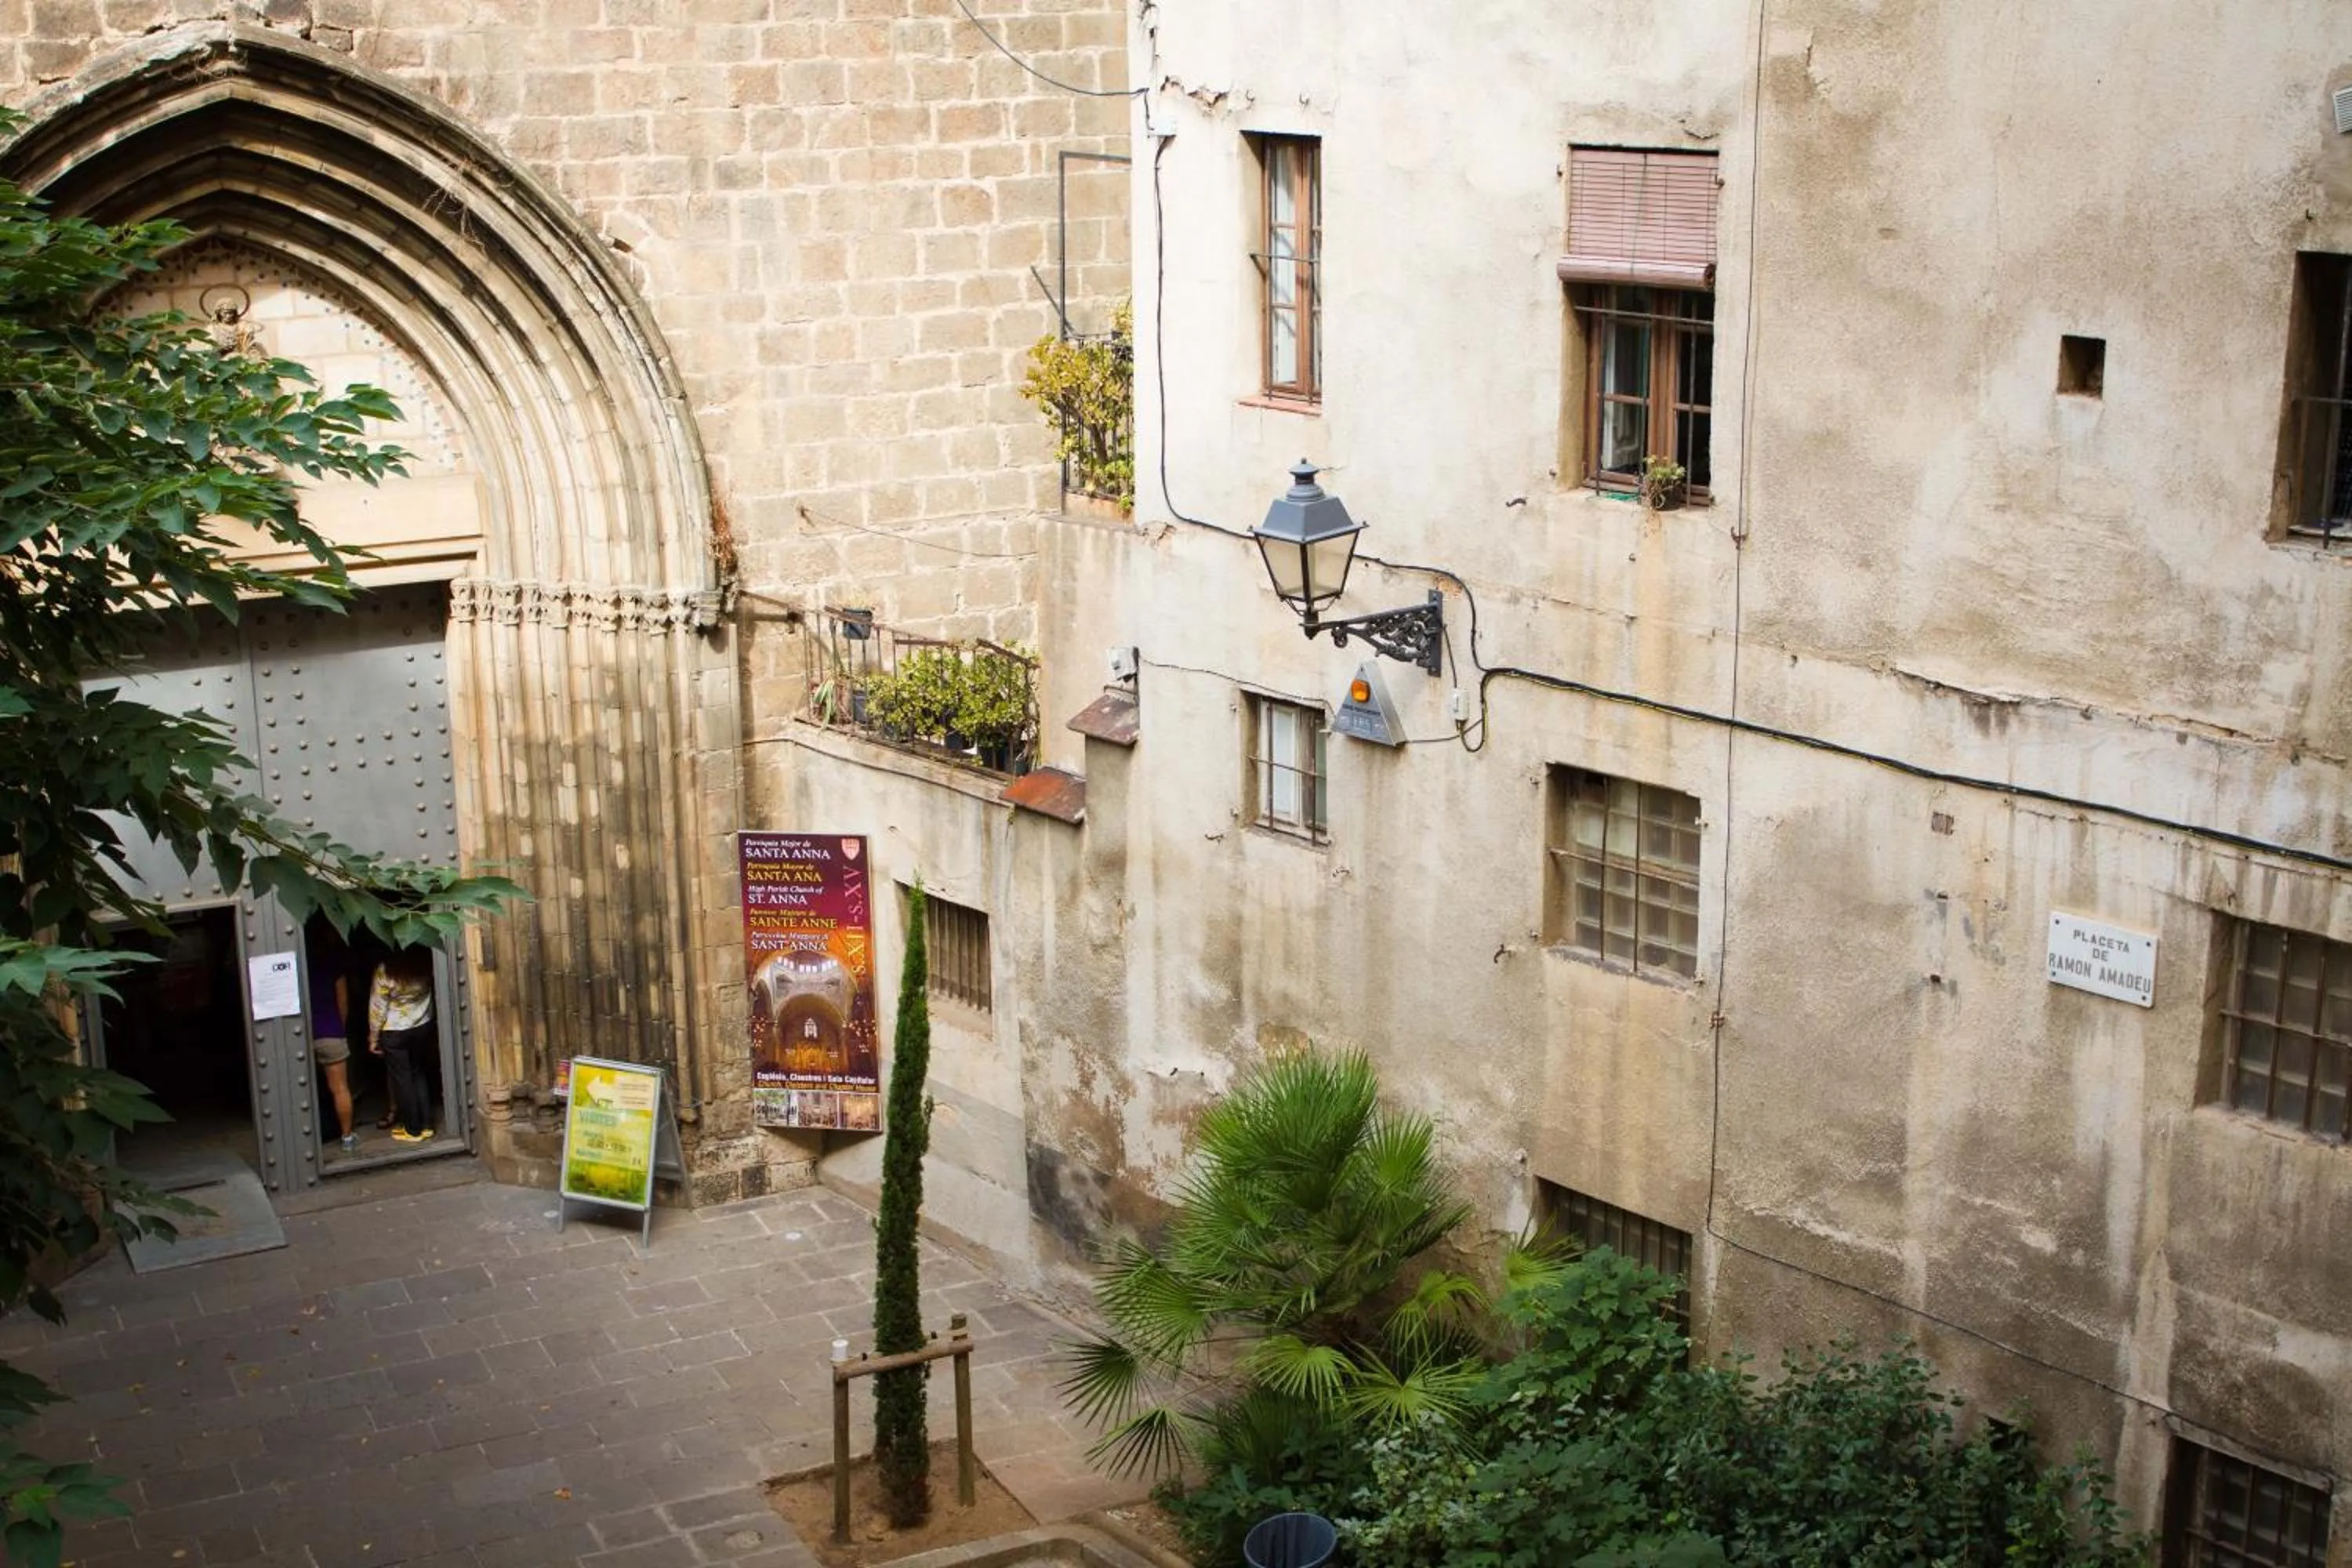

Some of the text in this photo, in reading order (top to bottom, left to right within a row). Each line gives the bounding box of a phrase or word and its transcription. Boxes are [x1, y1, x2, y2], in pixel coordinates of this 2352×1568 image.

[746, 848, 831, 859] SANTA ANNA
[747, 871, 822, 882] SANTA ANA
[748, 894, 808, 905] ST. ANNA
[750, 917, 838, 928] SAINTE ANNE
[2072, 929, 2130, 953] PLACETA
[2092, 948, 2110, 962] DE
[2049, 953, 2152, 993] RAMON AMADEU
